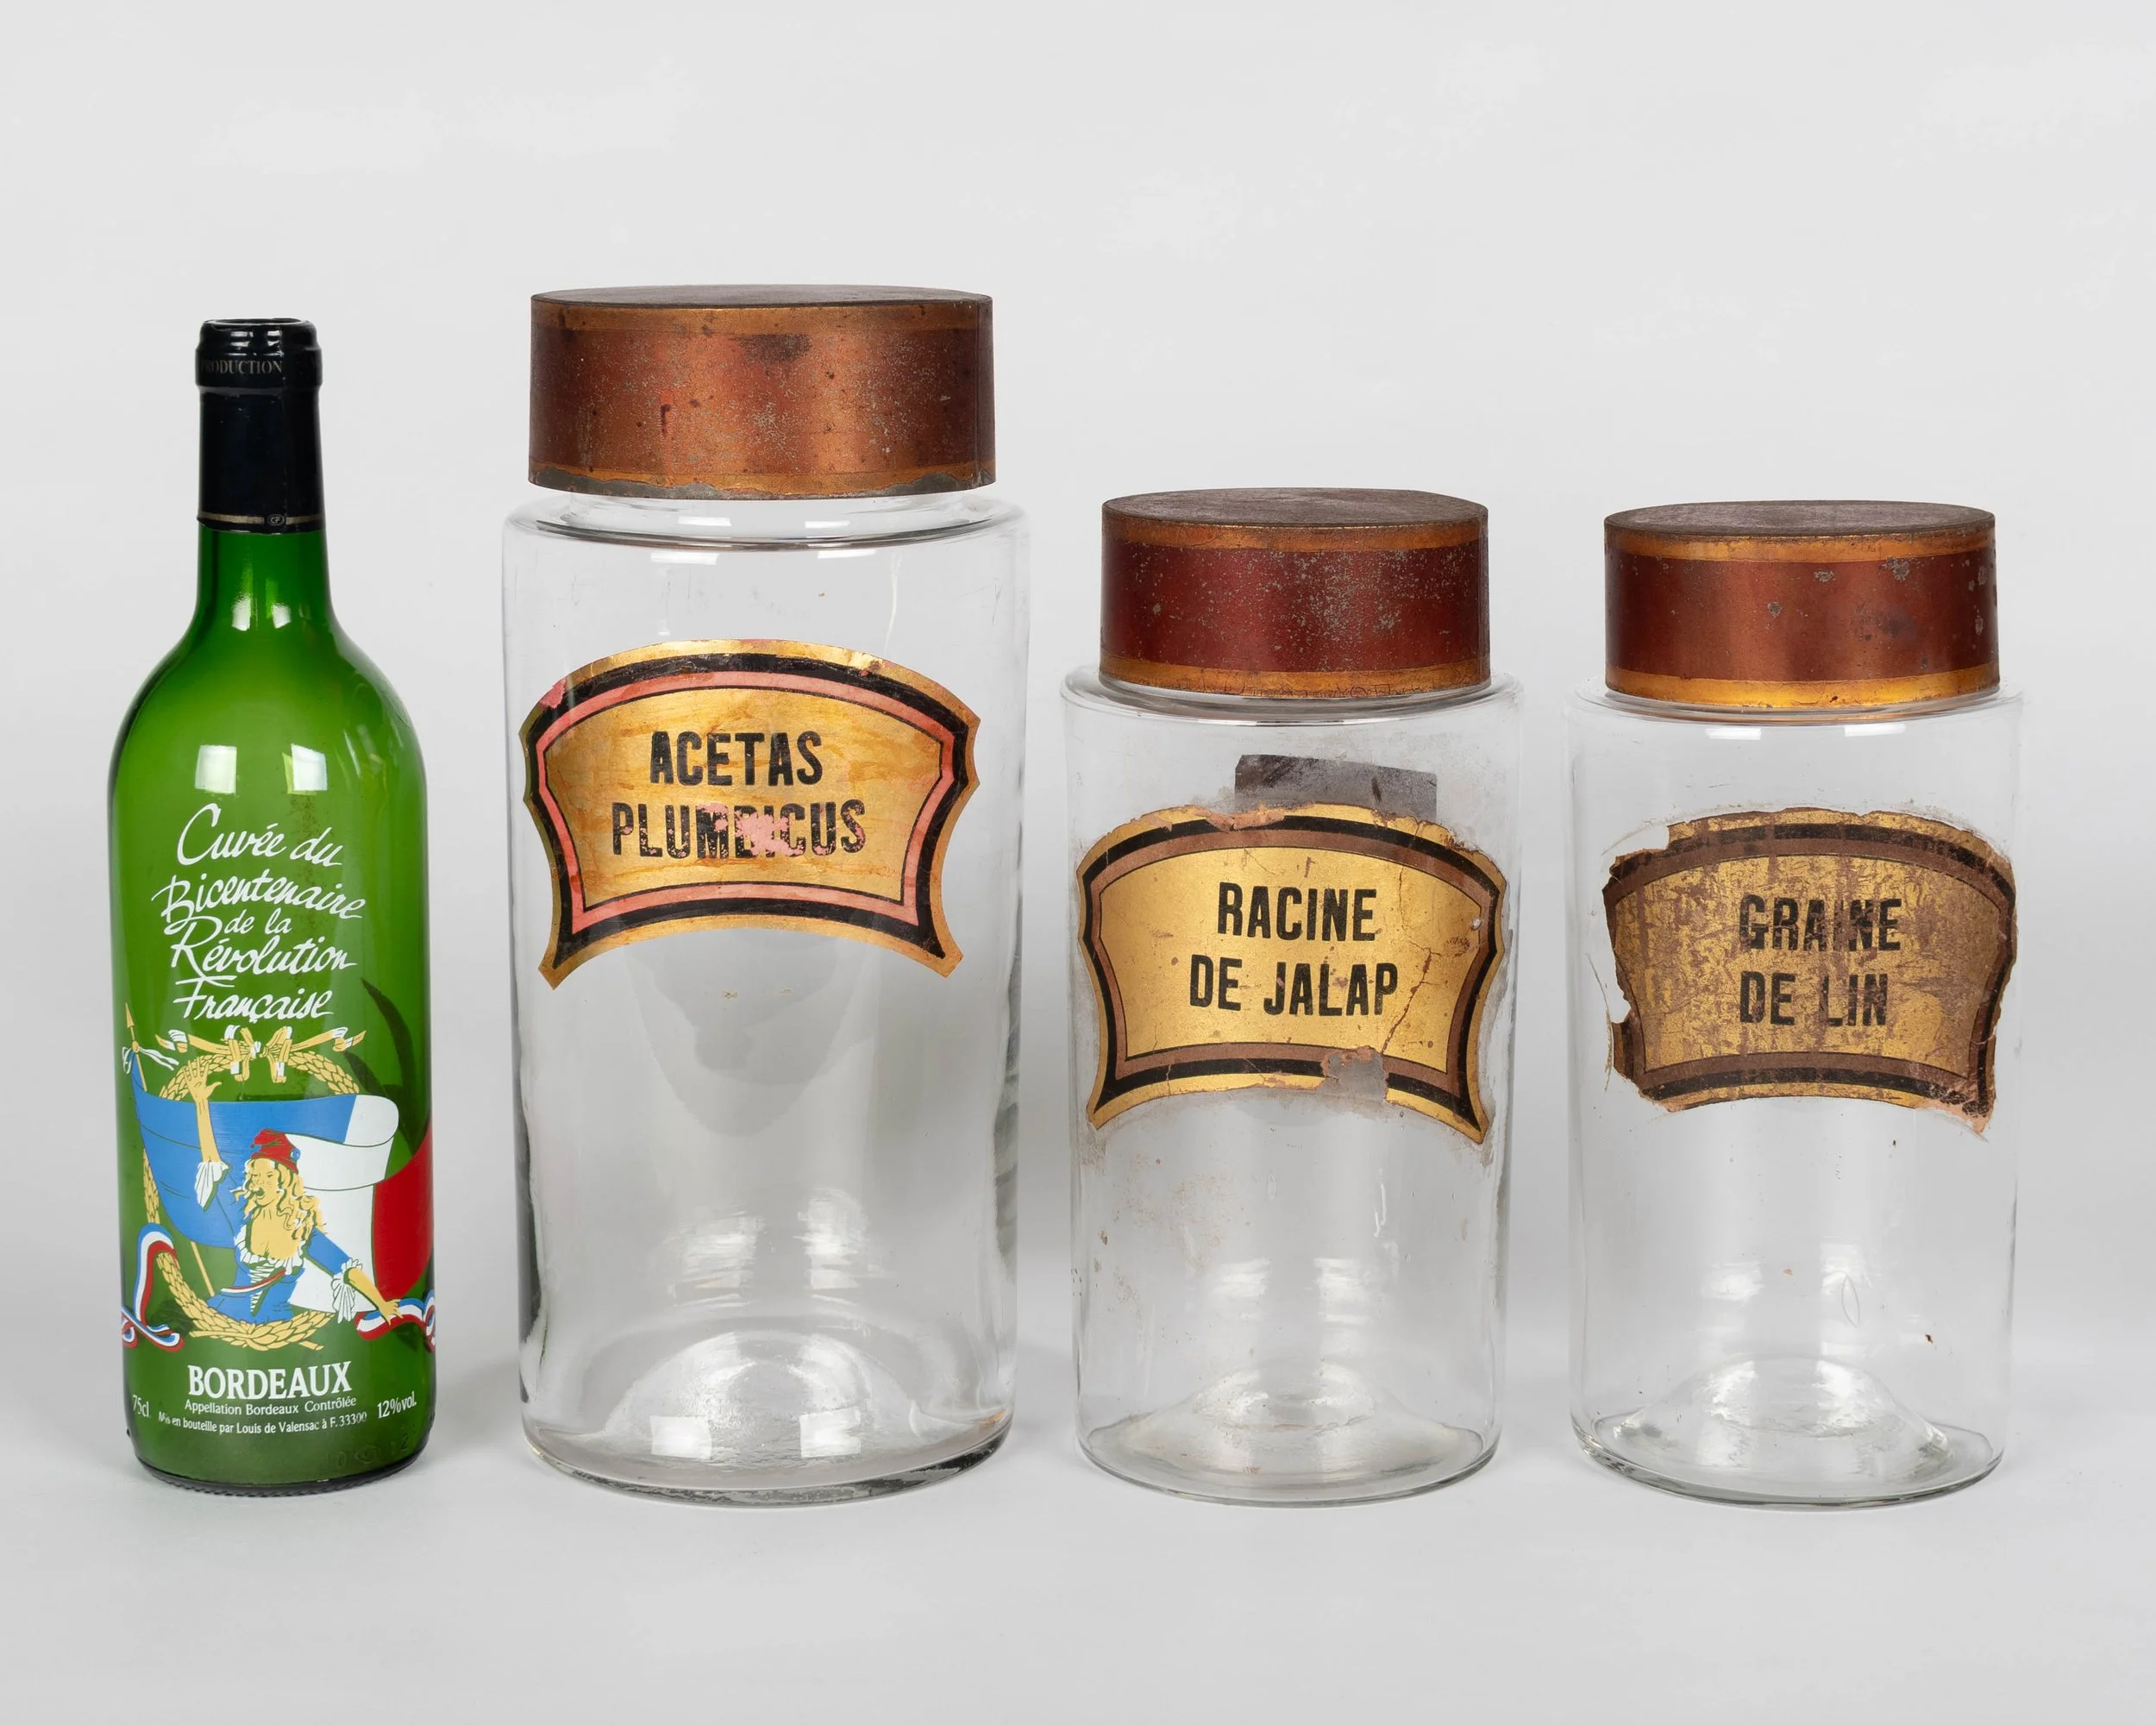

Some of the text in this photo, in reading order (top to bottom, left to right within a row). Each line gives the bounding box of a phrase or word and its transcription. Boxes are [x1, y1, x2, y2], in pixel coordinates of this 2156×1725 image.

[649, 731, 824, 786] ACETAS
[177, 803, 343, 867] Cuvée du
[151, 869, 366, 933] Bicentenaire
[224, 907, 292, 934] de la
[1217, 881, 1377, 942] RACINE
[164, 915, 358, 988] Révolution
[173, 975, 335, 1024] Française
[1190, 954, 1398, 1017] DE JALAP
[1739, 971, 1889, 1026] DE LIN
[185, 1396, 357, 1415] Appellation Bordeaux Contrôlée
[187, 1361, 352, 1399] BORDEAUX
[172, 1417, 181, 1427] en
[183, 1417, 217, 1432] bouteille
[219, 1424, 234, 1435] par
[236, 1422, 261, 1433] Louis
[264, 1422, 276, 1433] de
[322, 1419, 328, 1429] à
